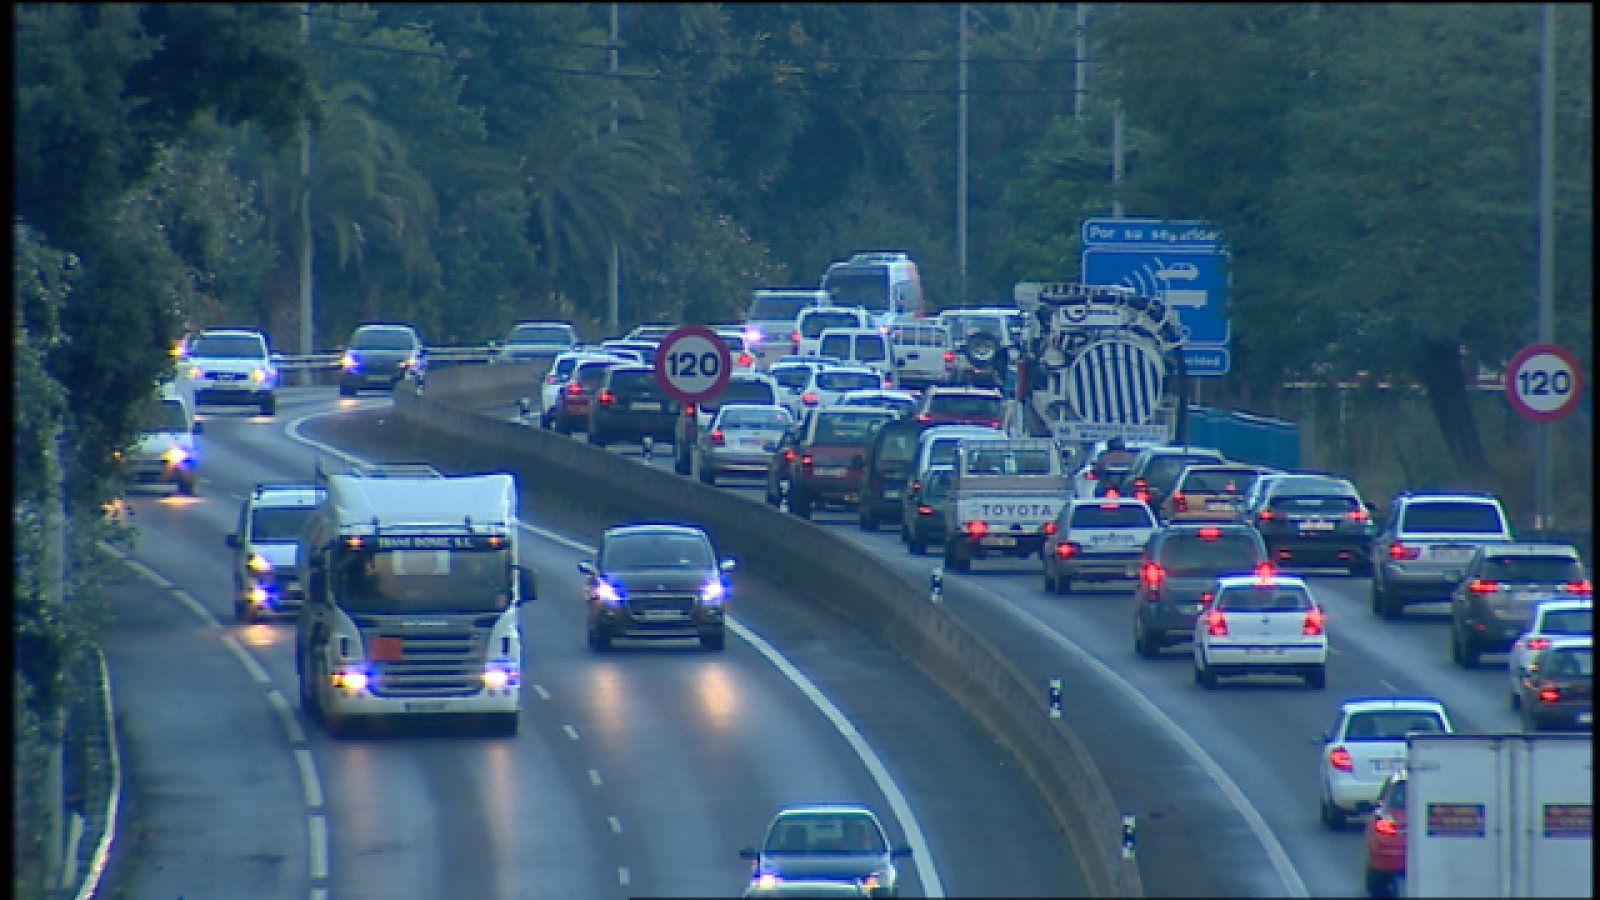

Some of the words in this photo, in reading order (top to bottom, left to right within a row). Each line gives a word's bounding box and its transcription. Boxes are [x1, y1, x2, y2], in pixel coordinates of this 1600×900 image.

[1089, 225, 1115, 239] Por
[667, 352, 718, 377] 120
[1519, 369, 1571, 395] 120
[981, 504, 1053, 516] TOYOTA
